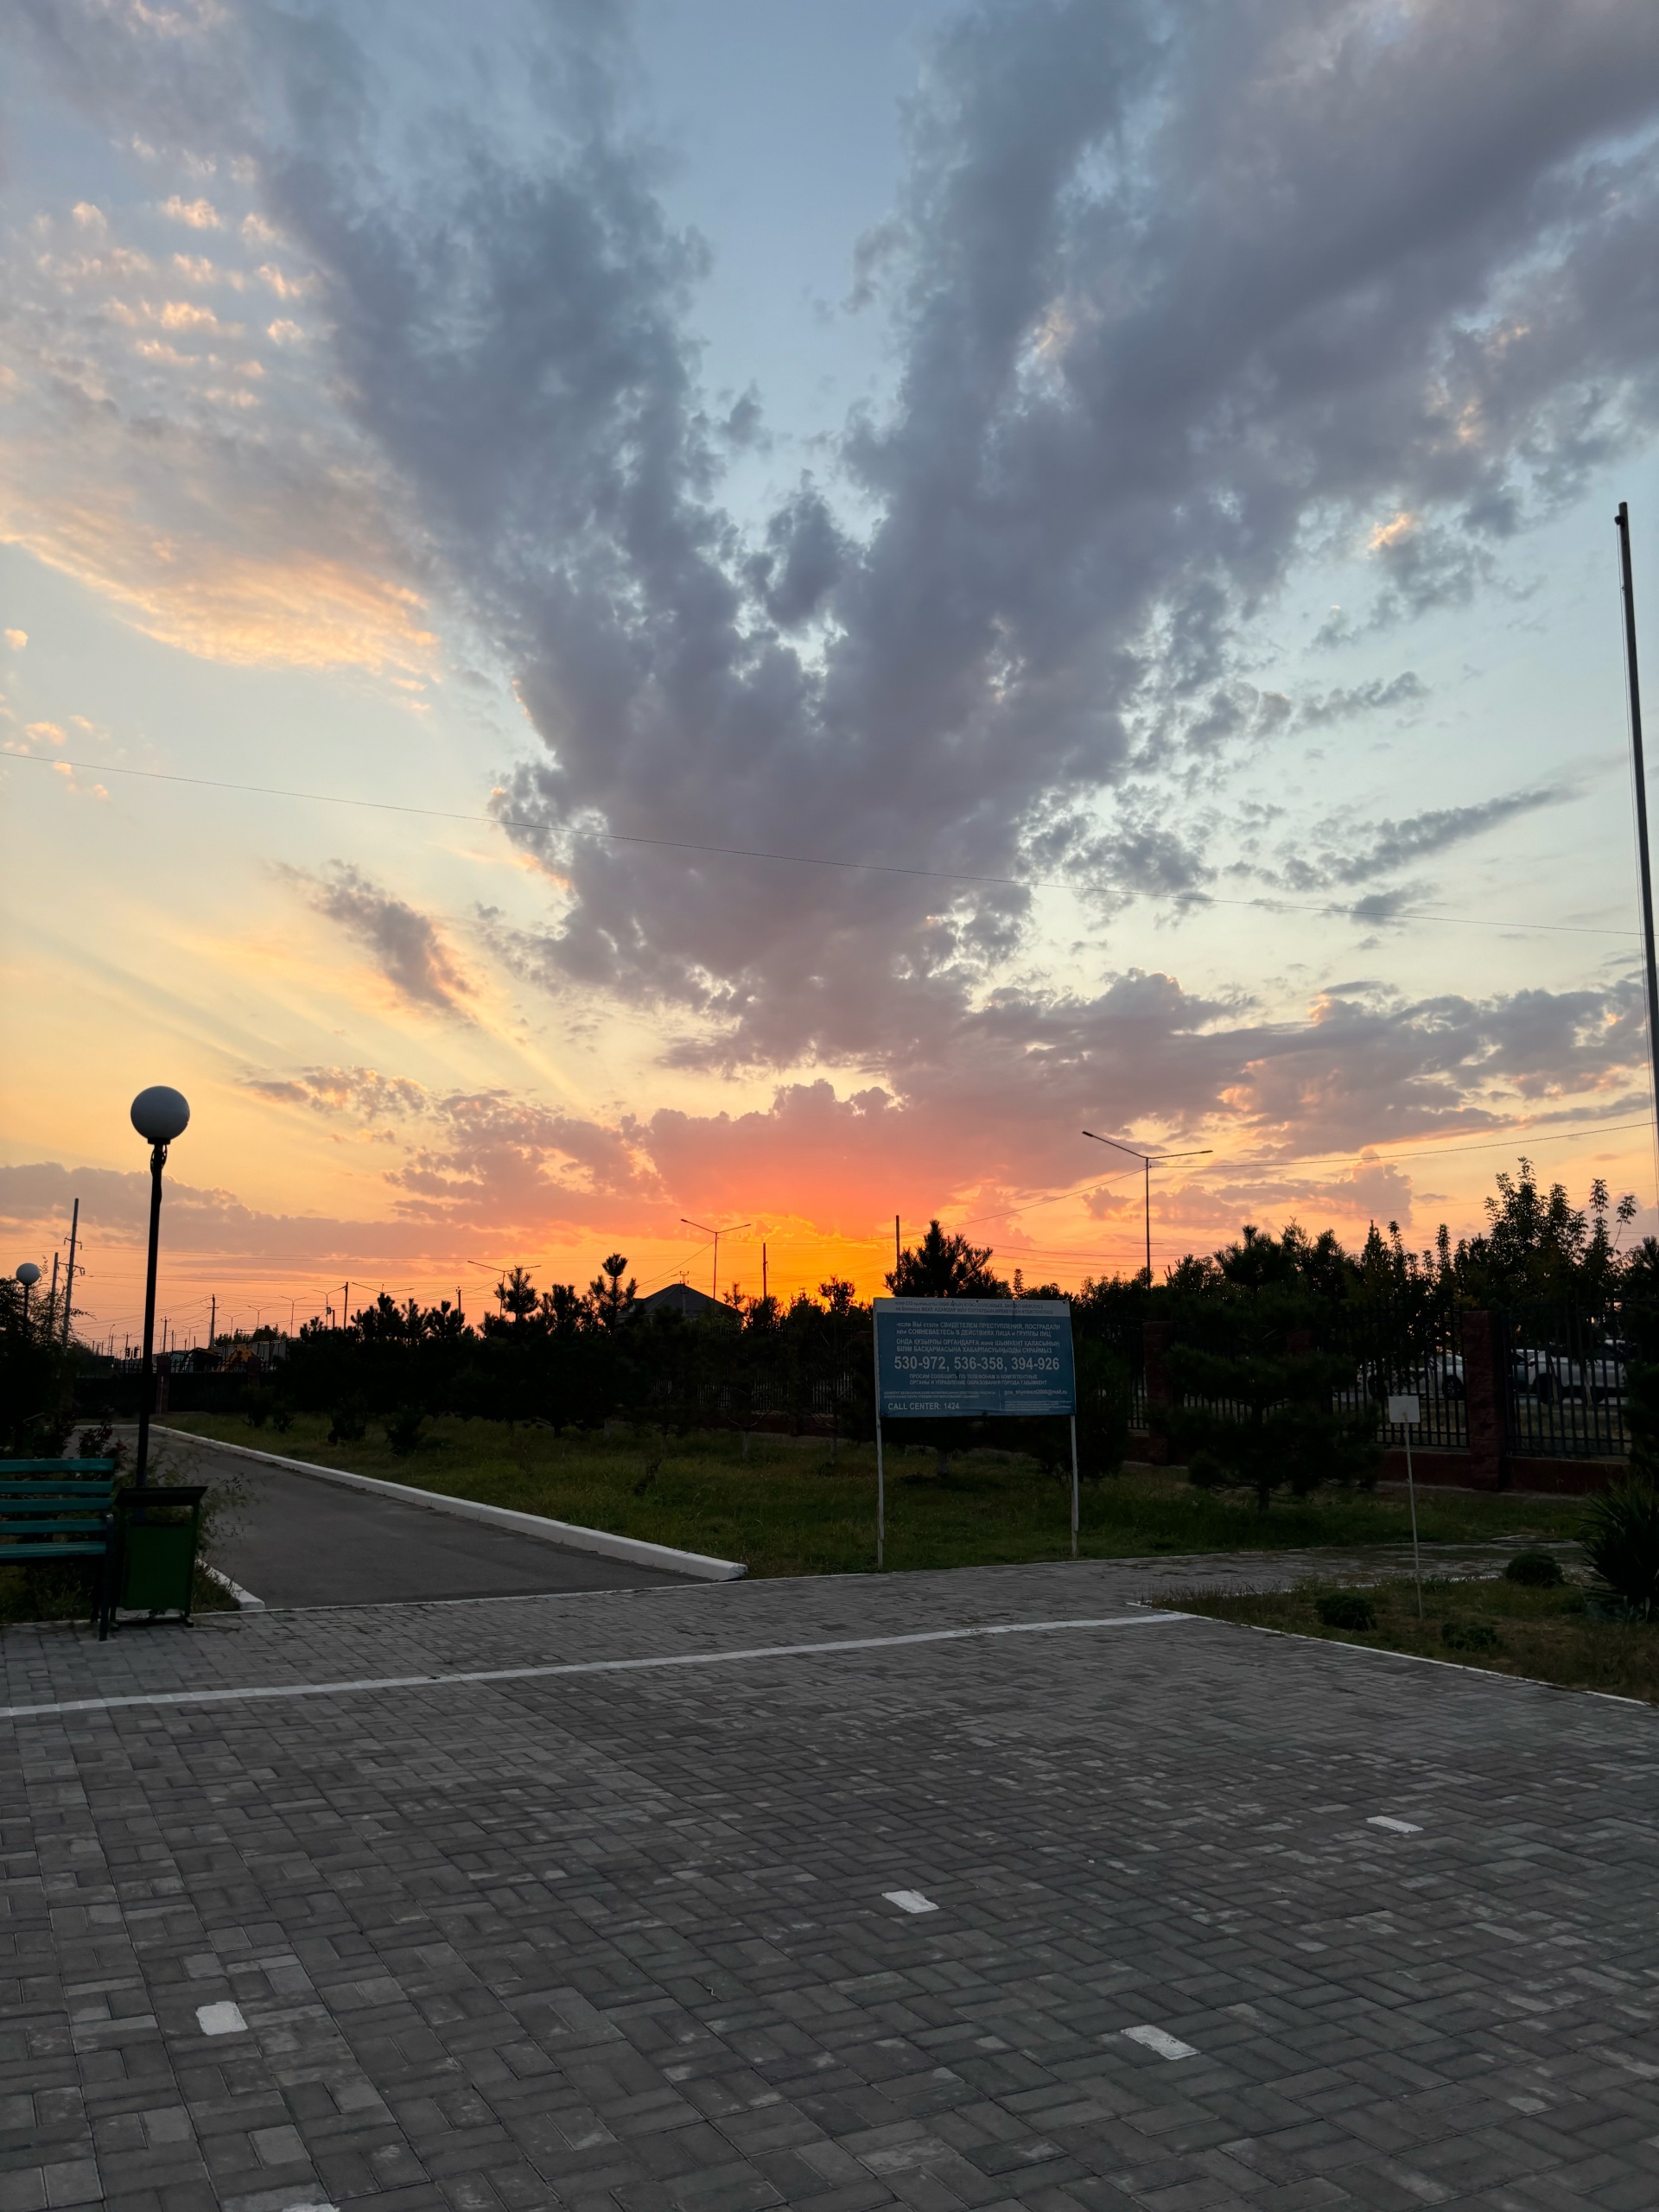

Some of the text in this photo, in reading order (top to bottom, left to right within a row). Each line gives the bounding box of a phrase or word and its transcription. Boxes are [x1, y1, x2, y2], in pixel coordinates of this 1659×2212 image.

[893, 1356, 1060, 1372] 530-972, 536-358, 394-926
